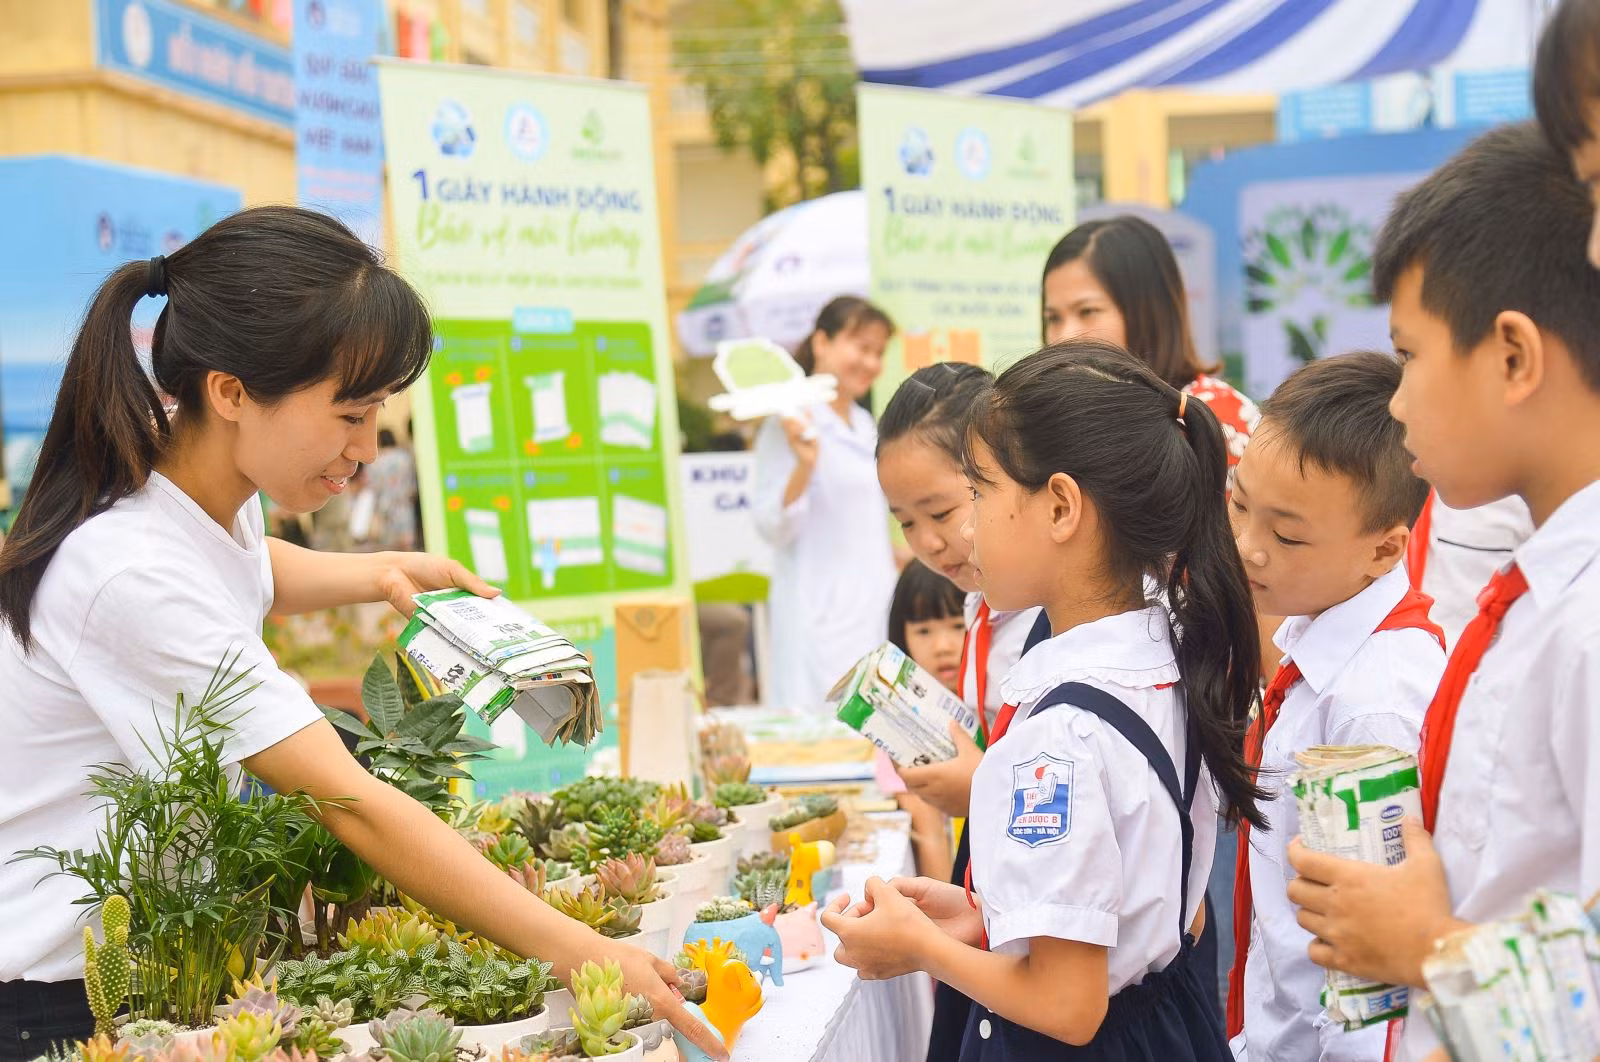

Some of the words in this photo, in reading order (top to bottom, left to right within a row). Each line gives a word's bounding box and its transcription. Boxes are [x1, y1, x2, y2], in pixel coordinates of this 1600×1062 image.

[413, 168, 428, 200] 1
[577, 186, 642, 214] ĐỘNG
[884, 187, 896, 213] 1
[1052, 816, 1058, 824] B
